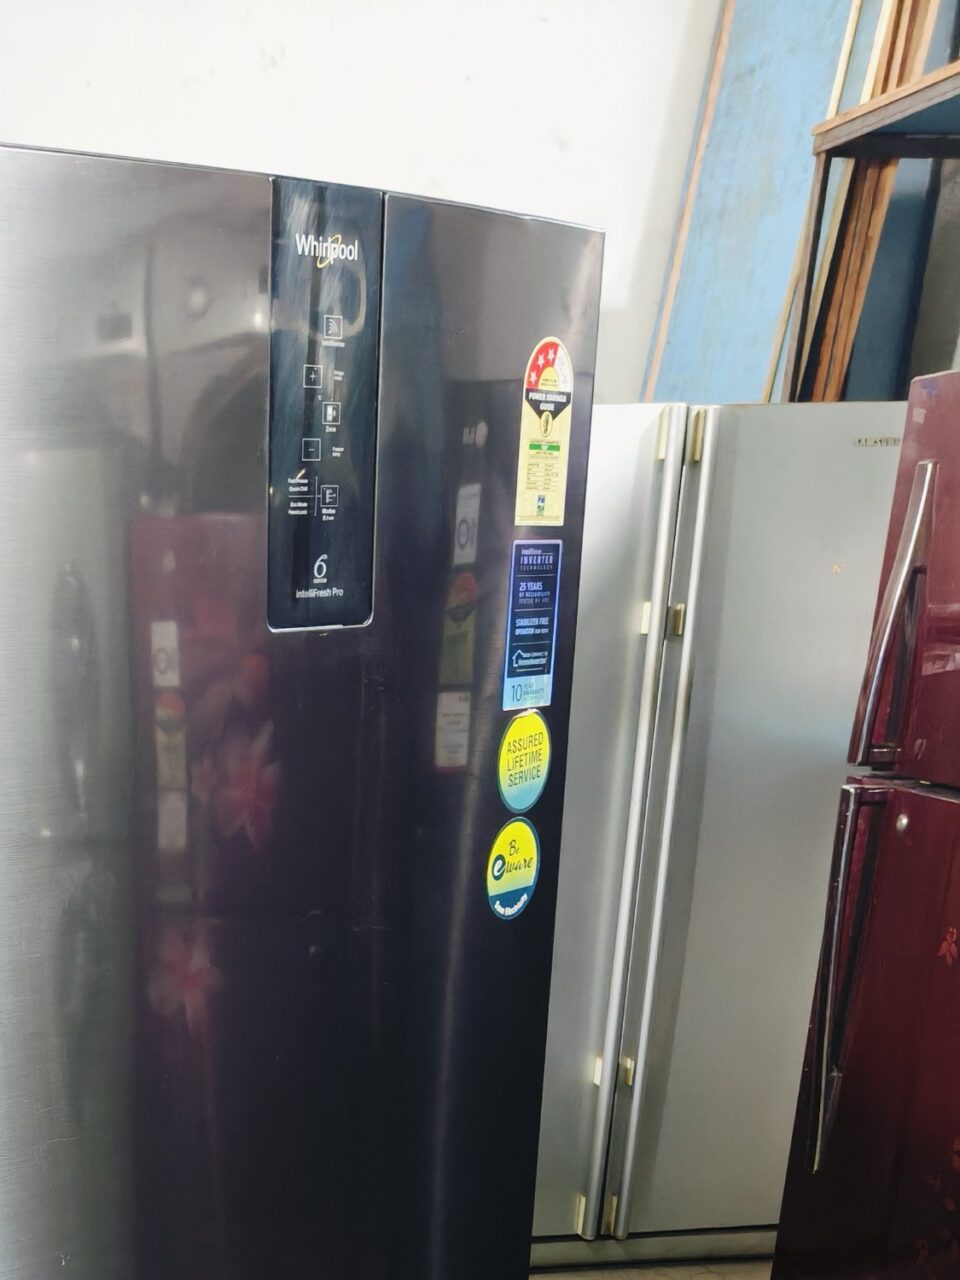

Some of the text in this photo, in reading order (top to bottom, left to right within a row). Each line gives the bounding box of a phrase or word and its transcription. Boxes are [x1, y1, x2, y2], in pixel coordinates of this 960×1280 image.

[295, 233, 358, 265] Whirlpool
[313, 553, 328, 578] 6
[520, 555, 553, 564] INVERTER
[295, 587, 344, 598] IntelliFresh Pro
[527, 581, 543, 591] YEARS
[511, 683, 523, 702] 10
[506, 732, 544, 754] ASSURED
[507, 748, 543, 772] LIFETIME
[508, 765, 541, 788] SERVICE
[508, 839, 520, 856] Be
